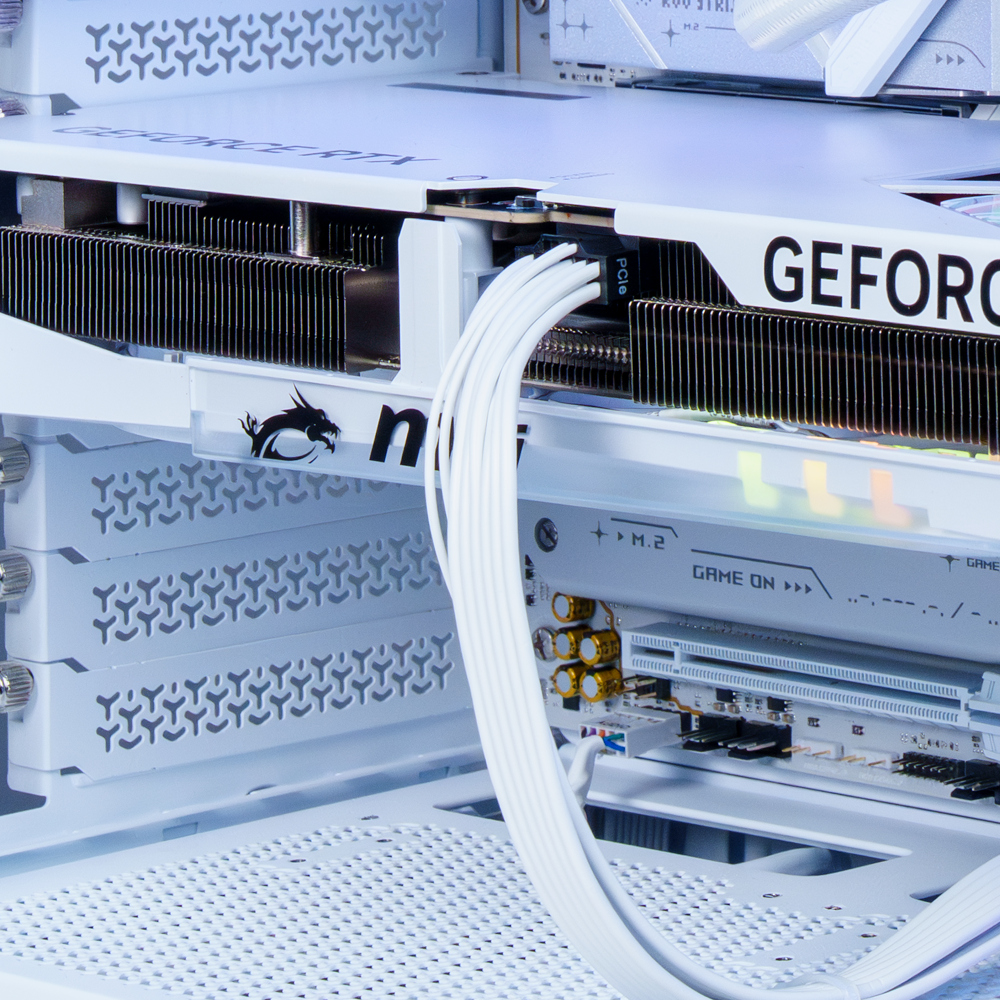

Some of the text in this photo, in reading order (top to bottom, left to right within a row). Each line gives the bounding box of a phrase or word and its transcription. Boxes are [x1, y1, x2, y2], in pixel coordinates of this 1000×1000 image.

[52, 126, 441, 165] GEFORCE RTX
[616, 257, 629, 295] PCIe
[632, 532, 665, 550] M.2
[692, 564, 775, 590] GAME ON
[966, 557, 1000, 572] GAME
